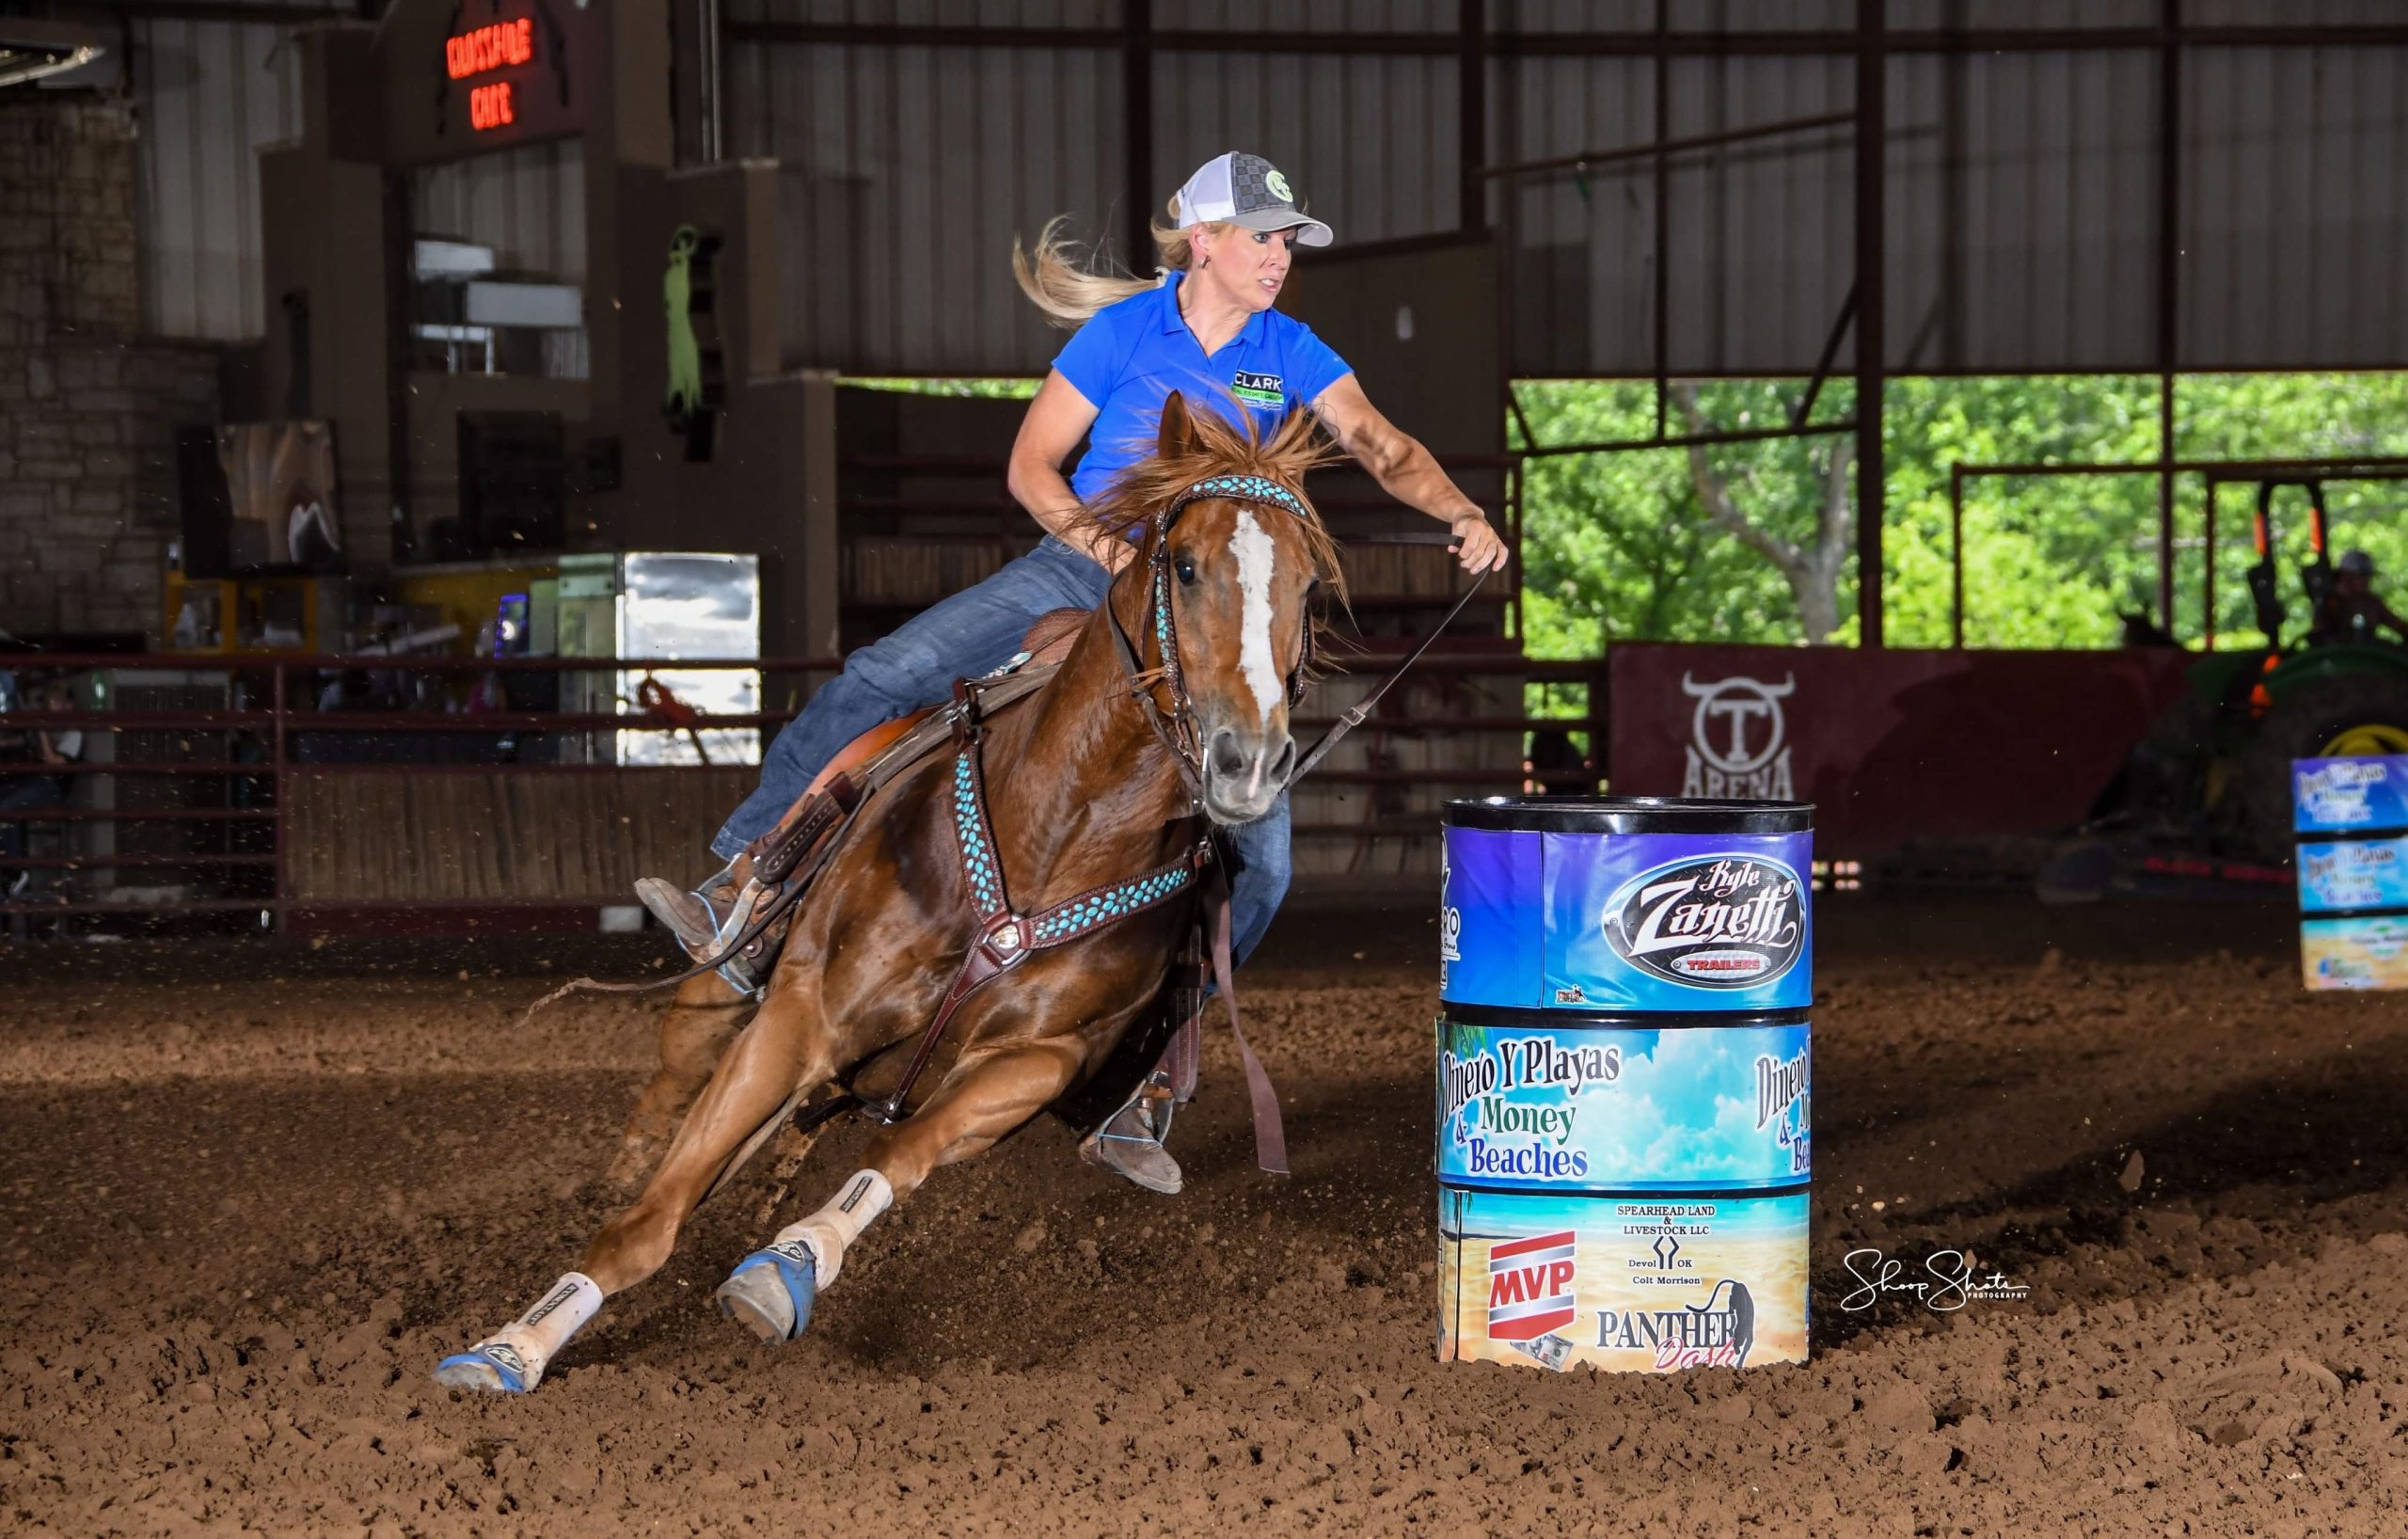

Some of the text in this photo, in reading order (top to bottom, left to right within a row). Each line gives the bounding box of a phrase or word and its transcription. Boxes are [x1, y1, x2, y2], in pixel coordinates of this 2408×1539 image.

[1234, 373, 1282, 391] CLARK
[1681, 745, 1795, 801] ARENA
[1699, 858, 1761, 897] Kyle
[1626, 875, 1798, 958] Zanetti
[1687, 960, 1761, 971] TRAILERS
[1445, 1039, 1620, 1123] Dinero Y Playas
[1757, 1051, 1806, 1129] Dinero
[1481, 1096, 1576, 1146] Money
[1779, 1112, 1791, 1145] &
[1456, 1111, 1588, 1177] & Beaches
[1618, 1206, 1716, 1215] SPEARHEAD LAND
[1663, 1215, 1671, 1225] &
[1624, 1226, 1709, 1235] LIVESTOCK LLC
[1489, 1260, 1575, 1309] MVP
[1597, 1310, 1735, 1348] PANTHER
[1656, 1336, 1736, 1369] Dash
